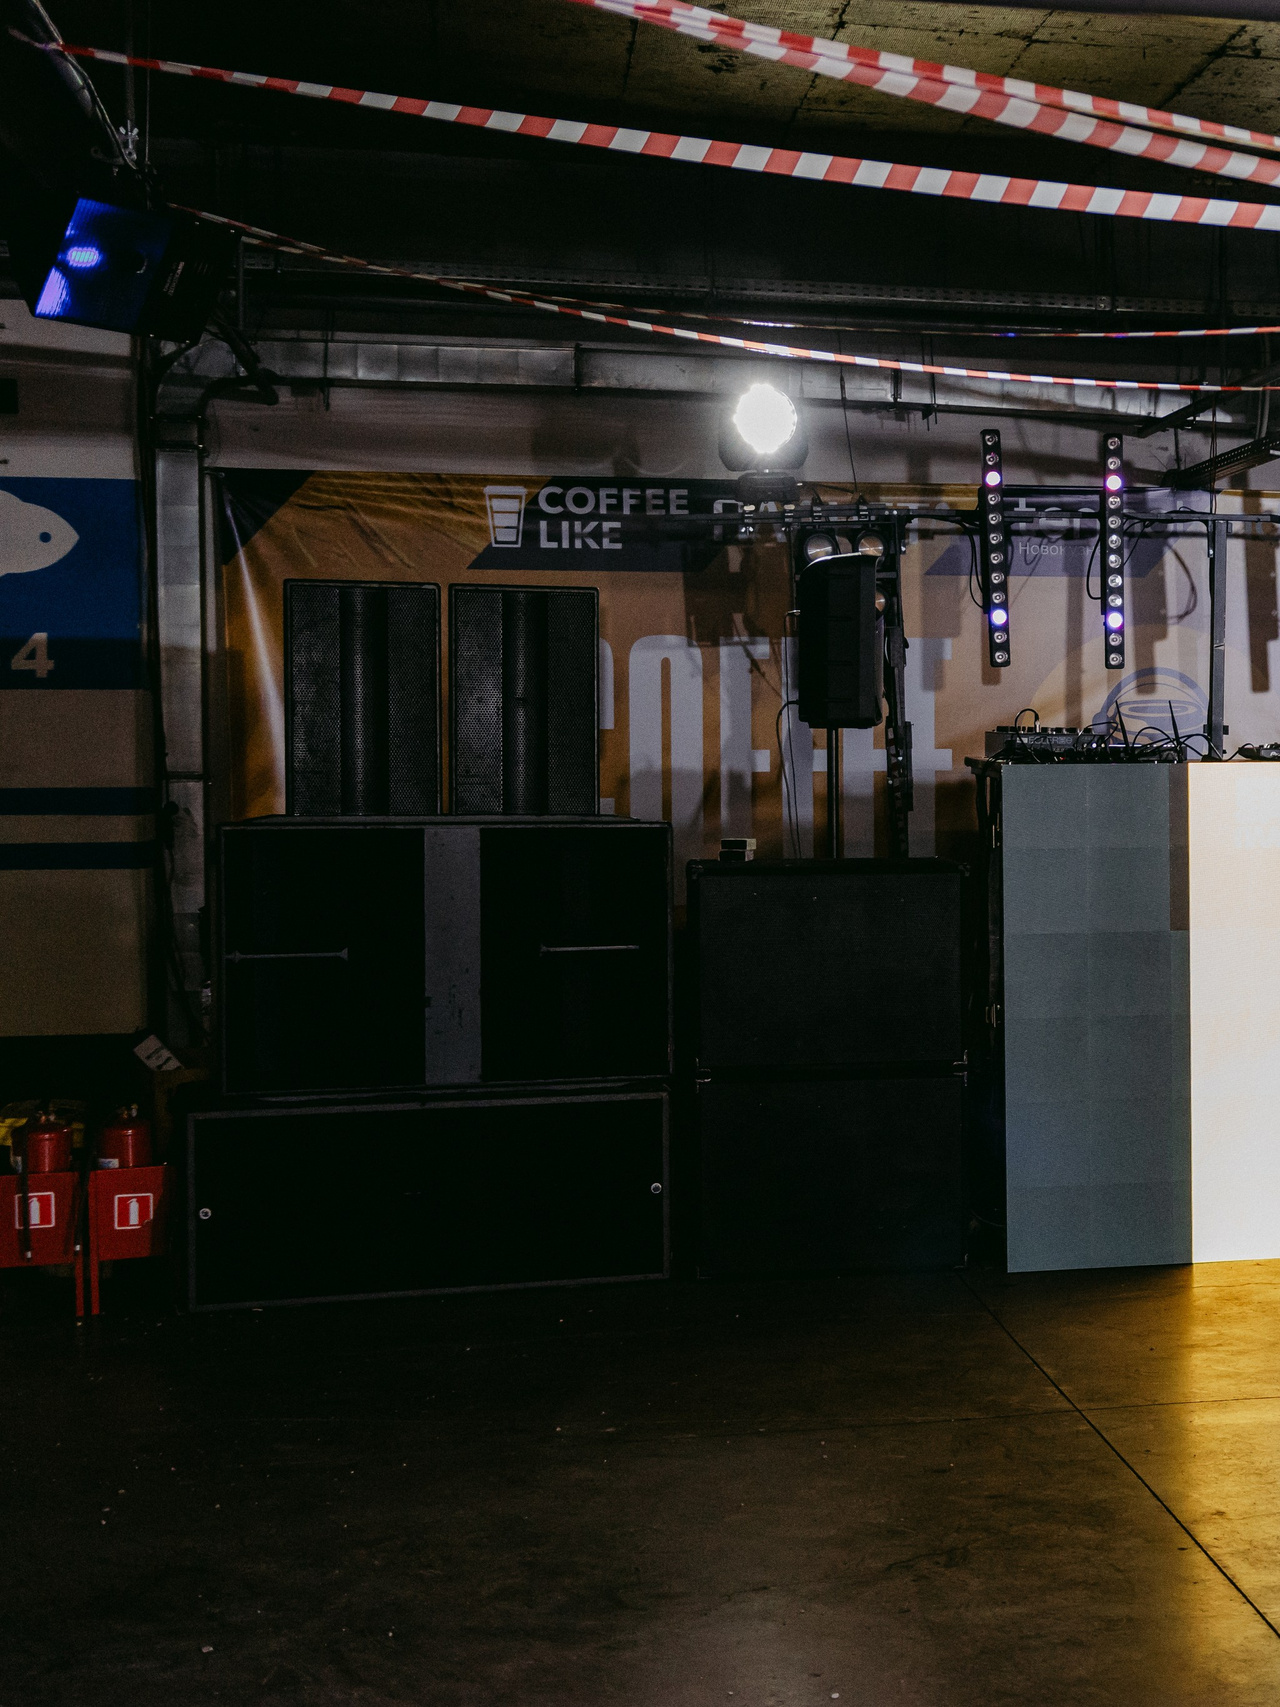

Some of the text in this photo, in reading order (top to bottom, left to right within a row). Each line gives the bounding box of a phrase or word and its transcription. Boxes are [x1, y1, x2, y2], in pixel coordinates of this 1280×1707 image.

[537, 485, 690, 515] COFFEE
[539, 520, 623, 550] LIKE
[10, 631, 55, 679] 4
